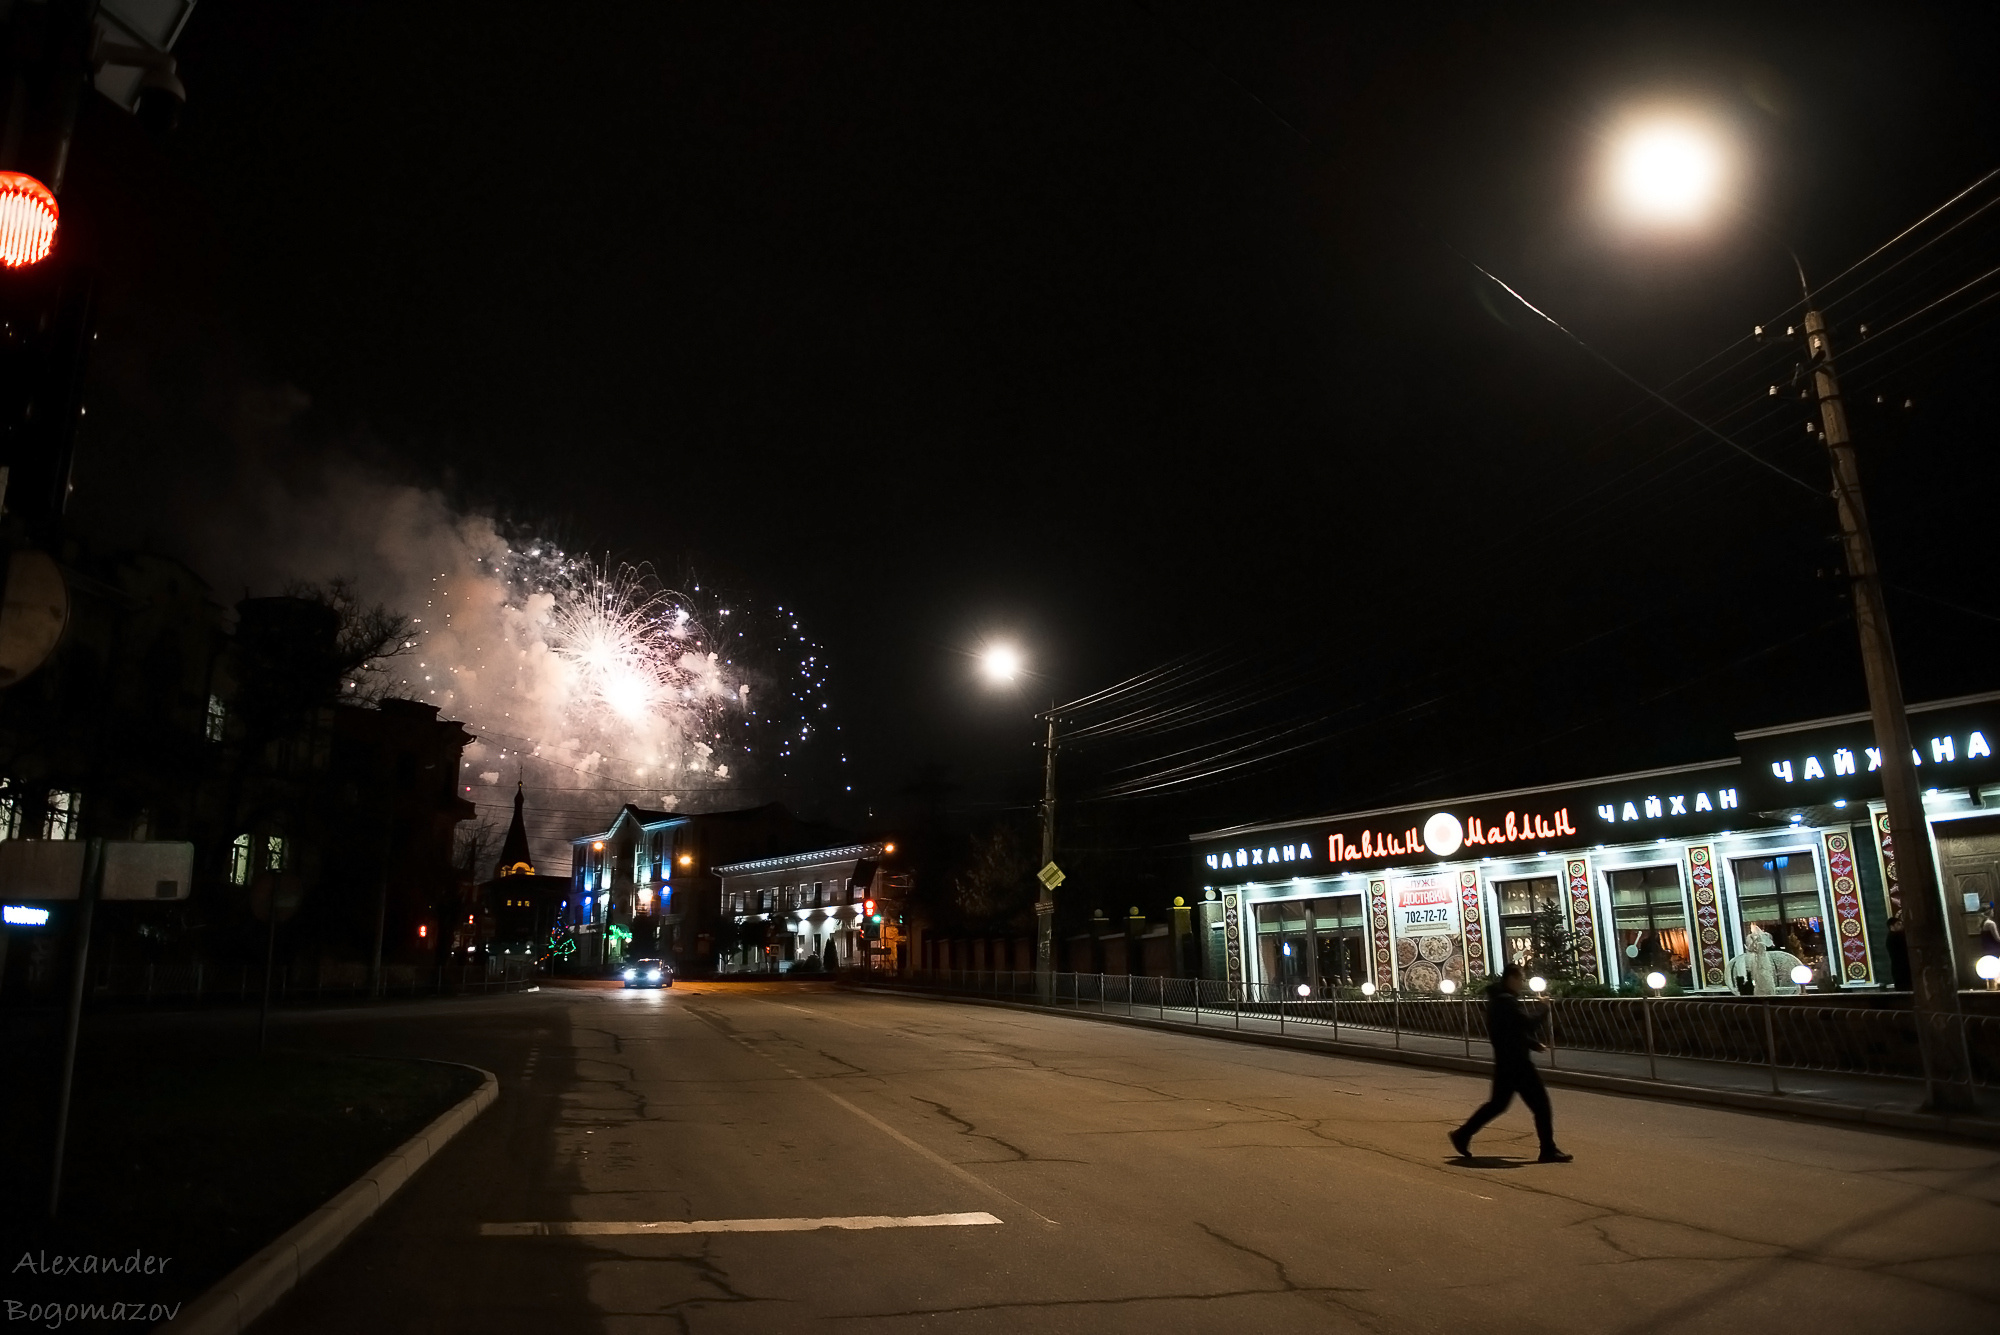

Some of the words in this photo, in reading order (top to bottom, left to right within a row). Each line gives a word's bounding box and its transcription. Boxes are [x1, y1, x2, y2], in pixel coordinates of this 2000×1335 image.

[1597, 787, 1739, 824] ЧАЙХАН
[1328, 827, 1425, 862] Павлин
[1464, 807, 1577, 848] Мавлин
[1206, 842, 1313, 870] ЧАЙХАНА
[1405, 908, 1448, 924] 702-72-72
